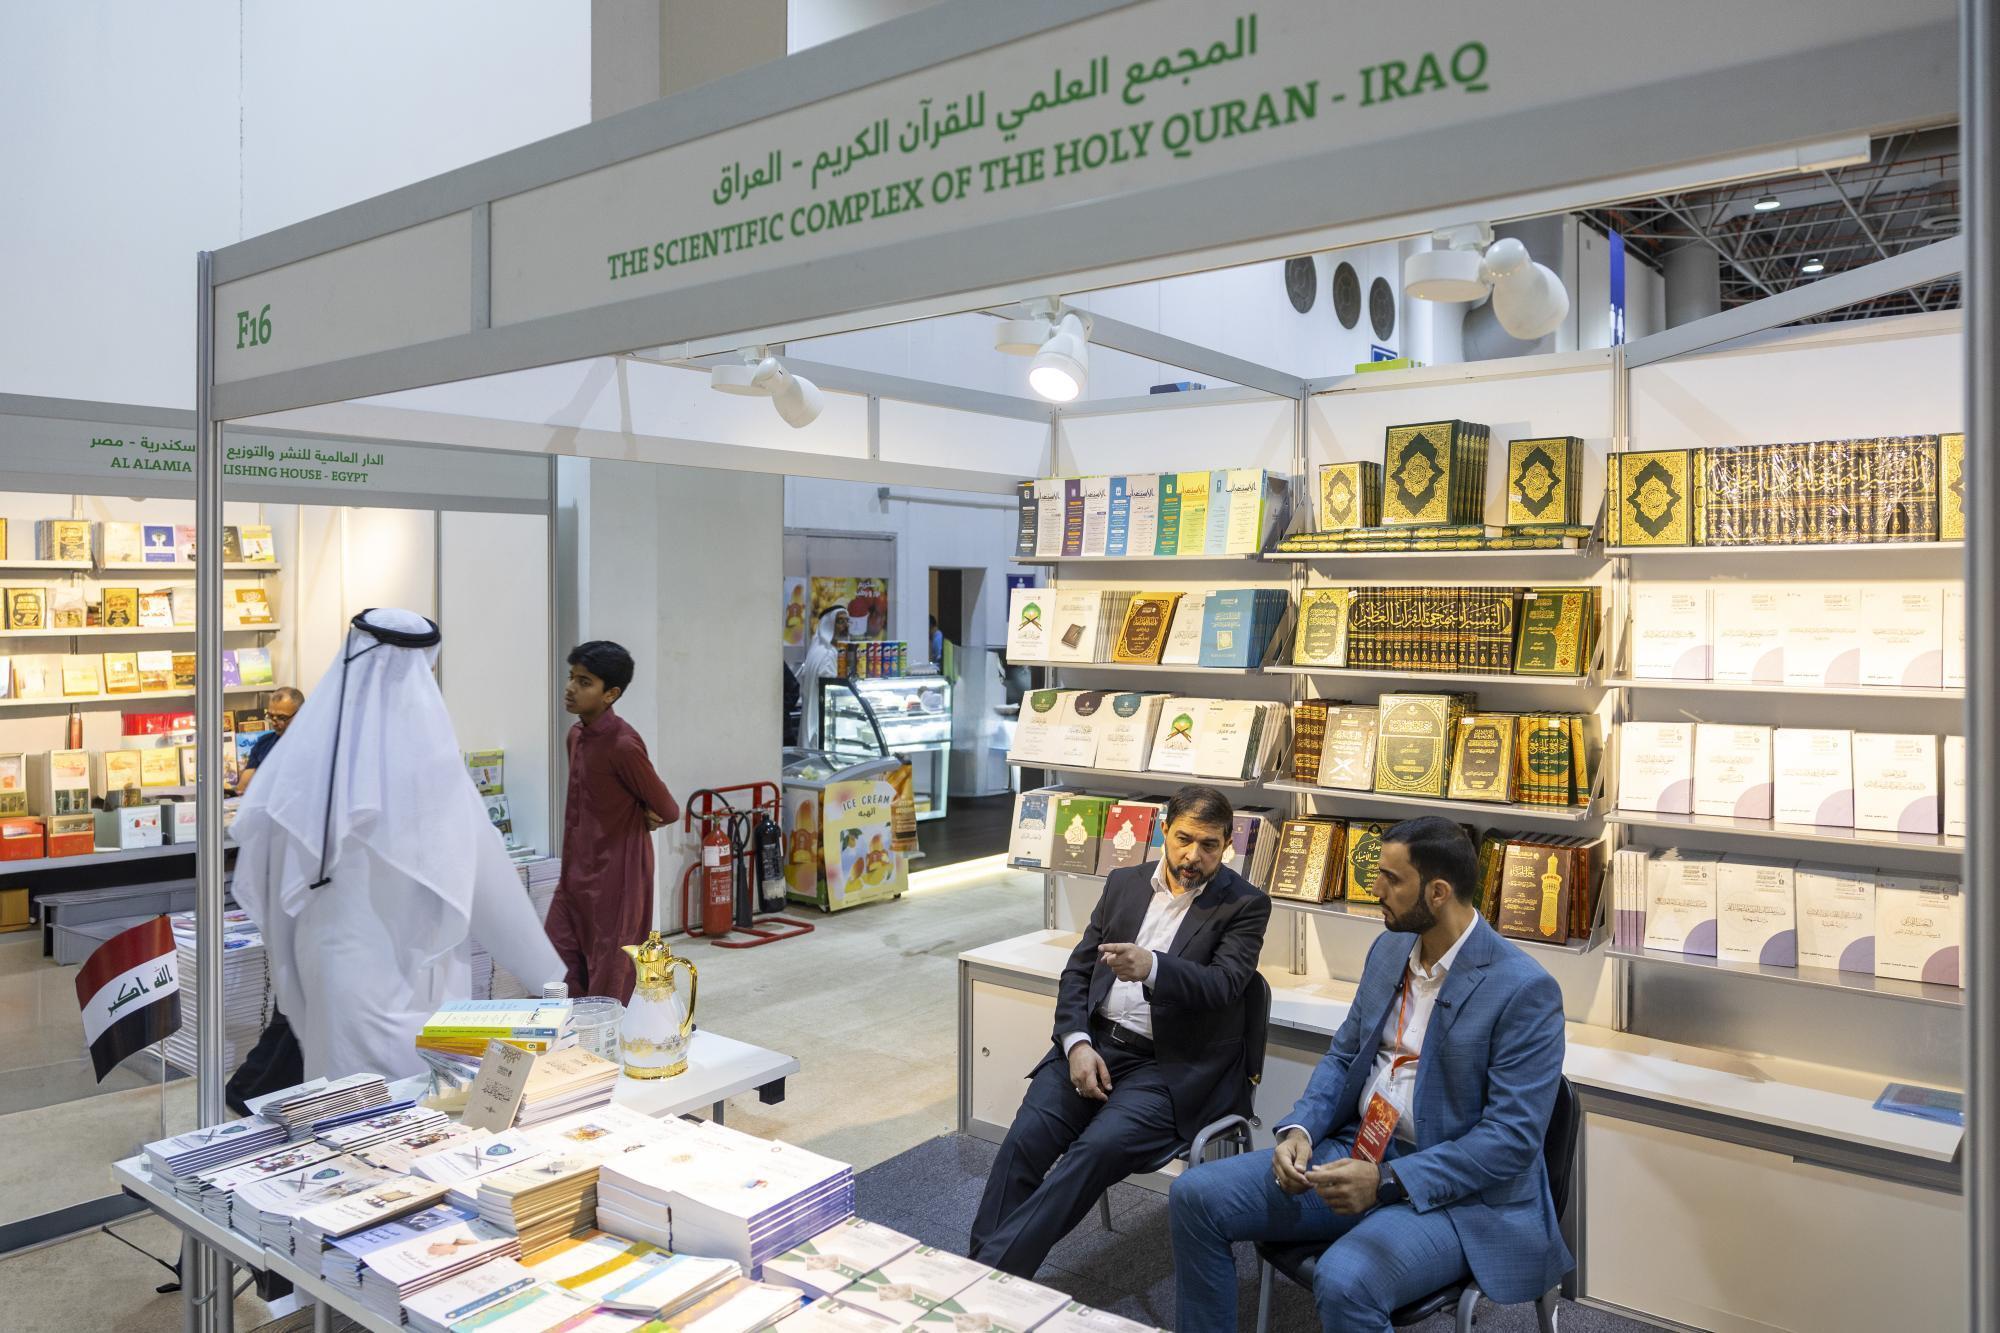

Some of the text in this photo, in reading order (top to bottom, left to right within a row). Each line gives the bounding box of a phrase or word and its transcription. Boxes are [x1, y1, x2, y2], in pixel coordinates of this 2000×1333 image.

[1121, 14, 1258, 106] المجمع
[995, 55, 1110, 144] العلمي
[898, 90, 988, 154] للقرآن
[607, 246, 650, 280] THE
[652, 212, 784, 271] SCIENTIFIC
[789, 178, 925, 238] COMPLEX
[930, 165, 973, 205] OF
[979, 148, 1047, 194] THE
[1052, 121, 1155, 178] HOLY
[1161, 79, 1319, 159] QURAN
[1358, 40, 1490, 108] IRAQ
[810, 117, 891, 190] الكريم
[711, 150, 783, 207] العراق
[236, 303, 273, 352] F16
[90, 437, 123, 448] مصر
[140, 436, 196, 453] سكندرية
[226, 445, 275, 460] والتوزيع
[279, 446, 311, 461] للنشر
[110, 456, 129, 469] AL
[133, 458, 193, 473] ALAMIA
[223, 464, 277, 478] LISHING
[279, 467, 322, 481] HOUSE
[331, 471, 368, 483] EGYPT
[314, 449, 358, 465] العالمية
[361, 453, 384, 467] الدار
[843, 794, 890, 811] ICE CREAM
[154, 964, 173, 988] الله
